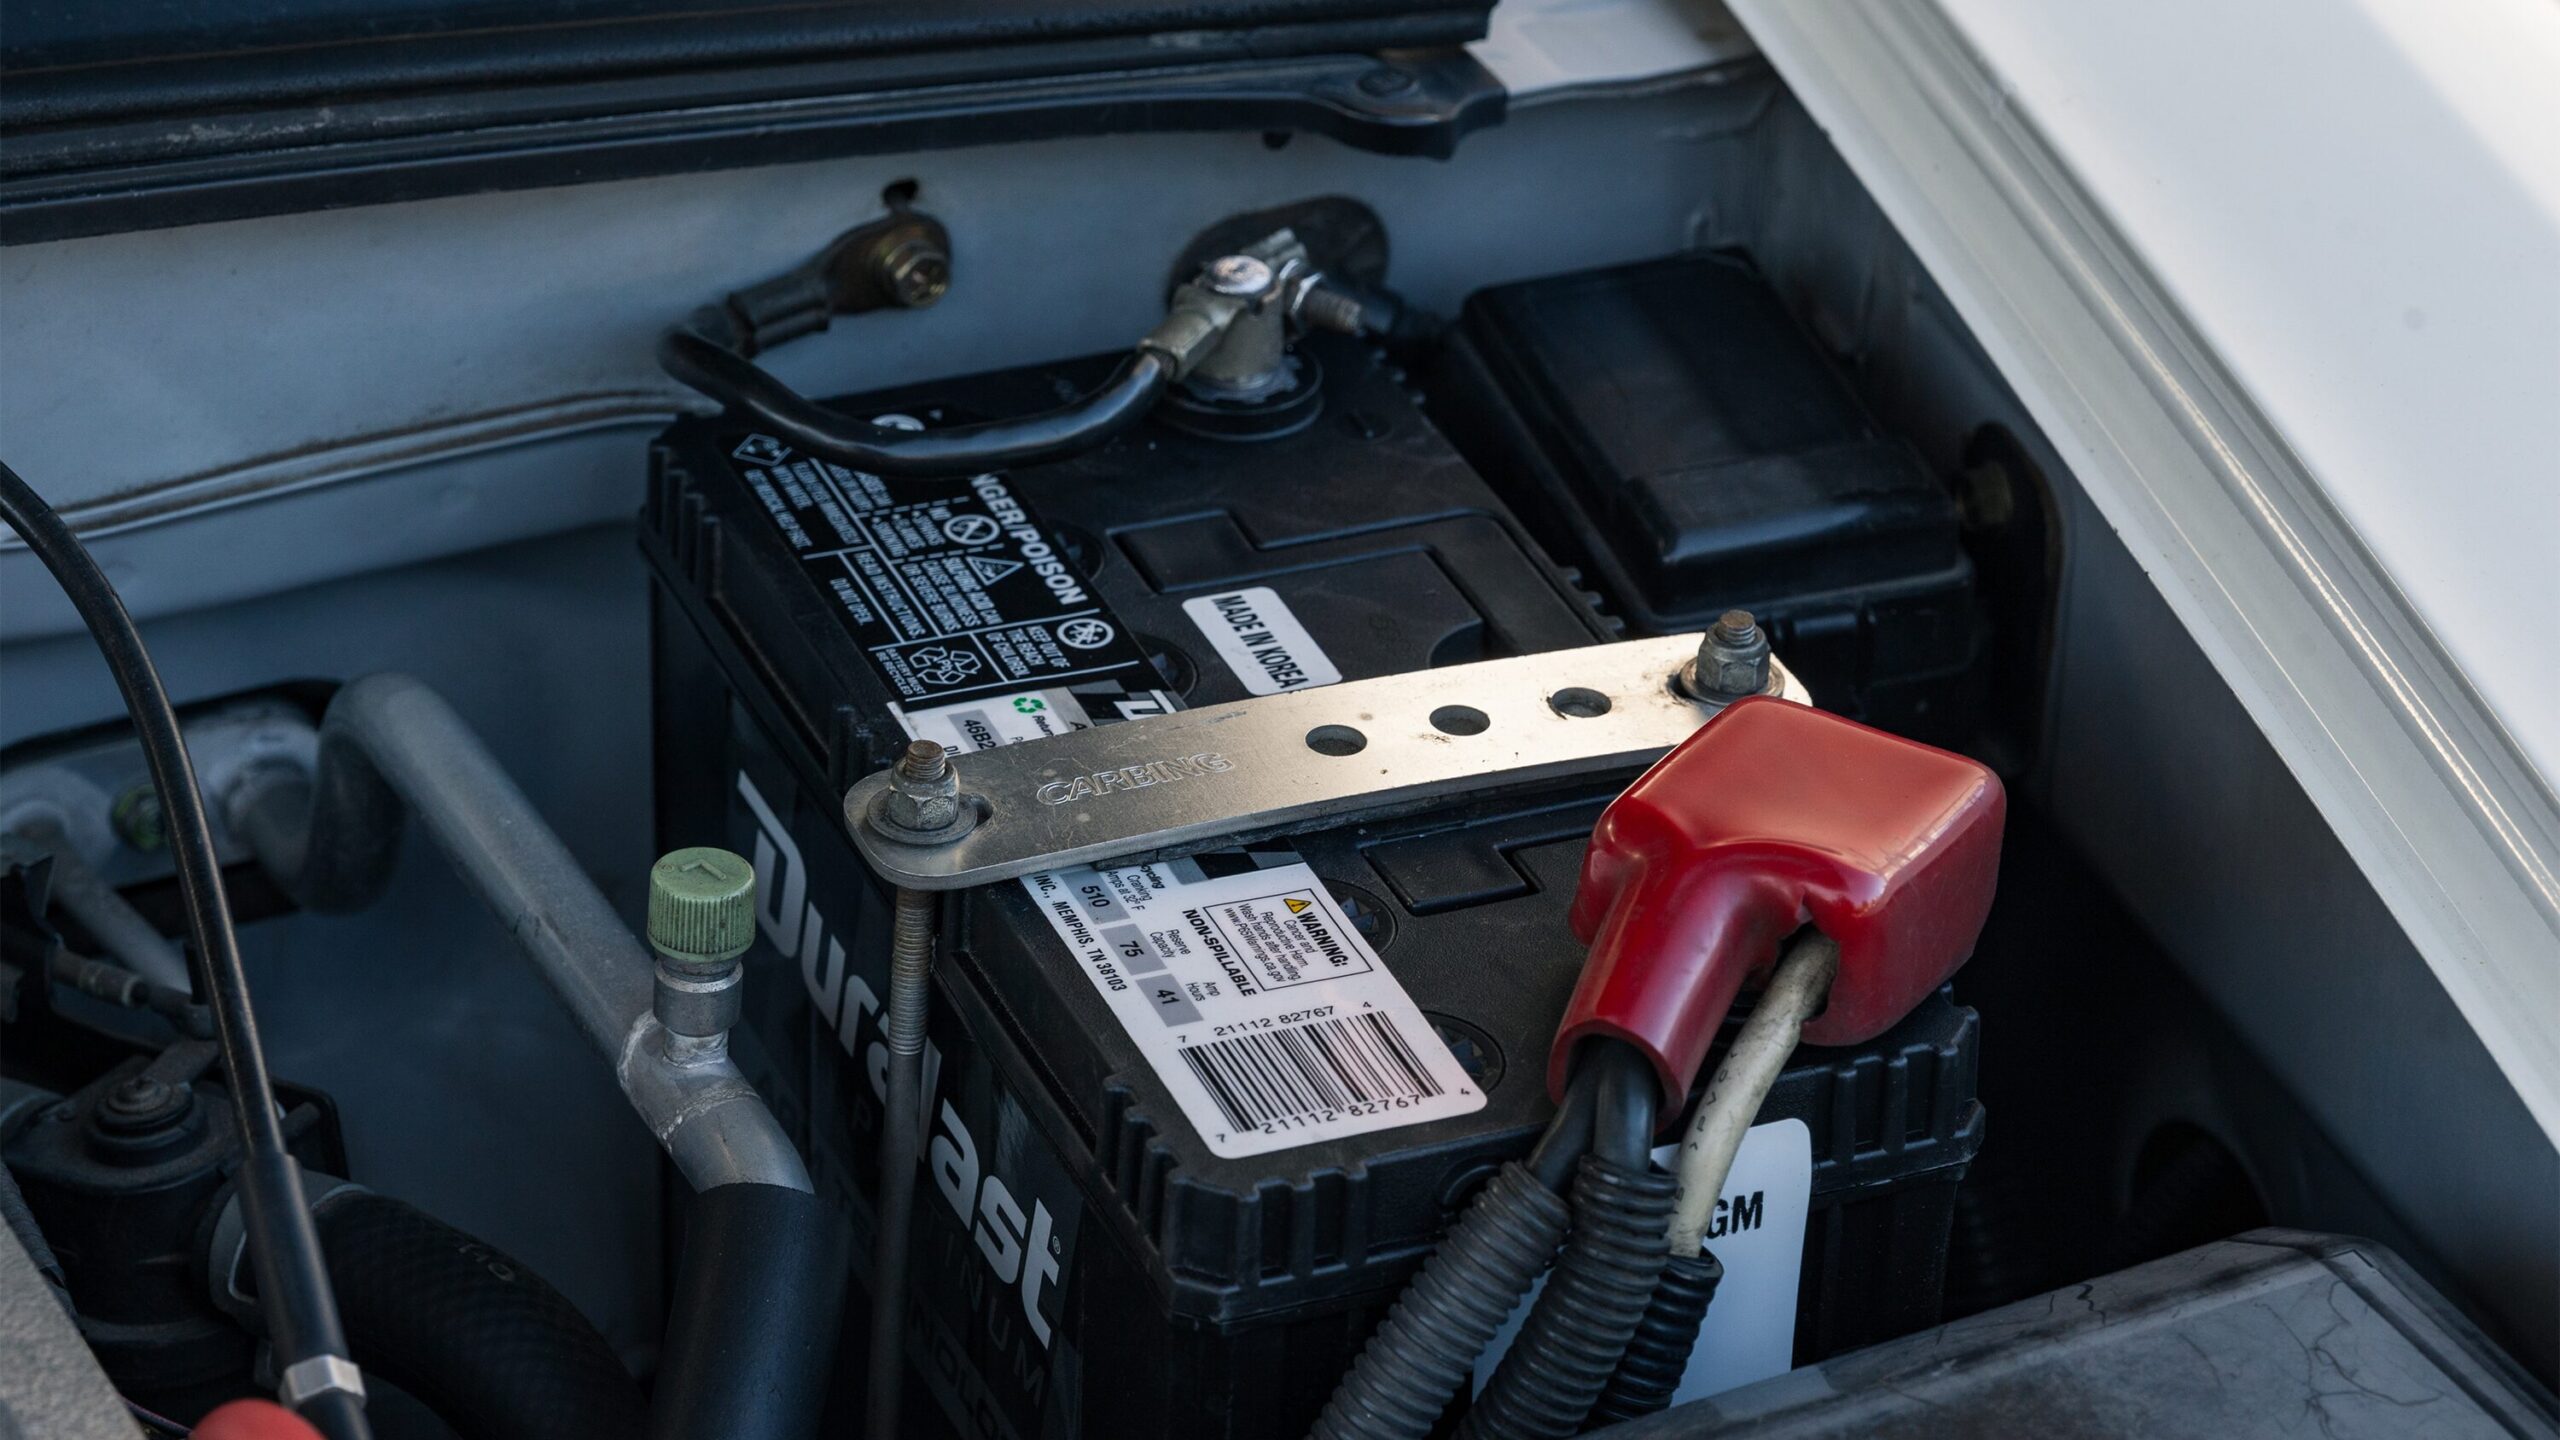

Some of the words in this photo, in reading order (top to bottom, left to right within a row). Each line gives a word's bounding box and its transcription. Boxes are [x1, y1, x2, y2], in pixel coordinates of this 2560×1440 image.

[901, 563, 922, 577] OR
[854, 552, 883, 577] READ
[870, 574, 926, 638] INSTRUCTIONS.
[911, 575, 943, 604] SEVERE
[921, 560, 951, 586] CAUSE
[939, 584, 982, 627] BLINDNESS
[966, 590, 995, 610] ACID
[980, 609, 1003, 625] CAN
[1211, 594, 1263, 633] MADE
[985, 632, 1006, 642] OF
[1006, 627, 1029, 644] THE
[1026, 625, 1052, 642] KEEP
[1241, 629, 1278, 647] IN
[993, 642, 1031, 679] CHILDREN.
[1016, 642, 1046, 666] REACH
[1040, 642, 1064, 658] OUT
[1050, 657, 1071, 668] OF
[882, 659, 914, 695] RECYCLED
[885, 648, 914, 679] BATTERY
[907, 674, 927, 695] MUST
[937, 659, 955, 674] Pb
[1252, 645, 1310, 689] KOREA
[1036, 752, 1236, 805] CARBING
[1106, 870, 1125, 890] Amps
[1126, 874, 1153, 902] Cranking
[1081, 885, 1111, 908] 510
[1052, 901, 1095, 948] MEMPHIS,
[1283, 919, 1308, 943] Cancer
[1299, 940, 1318, 954] and
[1119, 940, 1145, 957] 75
[1149, 931, 1176, 958] Capacity
[1165, 928, 1191, 955] Reserve
[1182, 909, 1257, 997] NON-SPILLABLE
[1223, 907, 1287, 983] www.P65Warnings.ca.gov
[1238, 903, 1258, 922] Wash
[1249, 920, 1272, 941] hands
[1264, 938, 1281, 955] after
[1274, 952, 1302, 981] handling.
[1260, 911, 1295, 951] Reproductive
[1288, 949, 1309, 968] Harm.
[1296, 911, 1349, 967] WARNING:
[1087, 947, 1107, 962] TN
[1096, 962, 1128, 992] 38103
[1202, 982, 1221, 997] Amp
[1157, 989, 1180, 1005] 41
[1185, 982, 1206, 1002] Hours
[1177, 1035, 1188, 1044] 7
[1214, 1017, 1274, 1037] 21112
[1278, 1005, 1335, 1025] 82767
[1215, 1133, 1226, 1144] 7
[1261, 1110, 1338, 1135] 21112
[1348, 1094, 1421, 1117] 82767
[1459, 1088, 1471, 1096] 4
[1705, 1190, 1764, 1239] GM
[853, 1091, 1047, 1408] PTINUM
